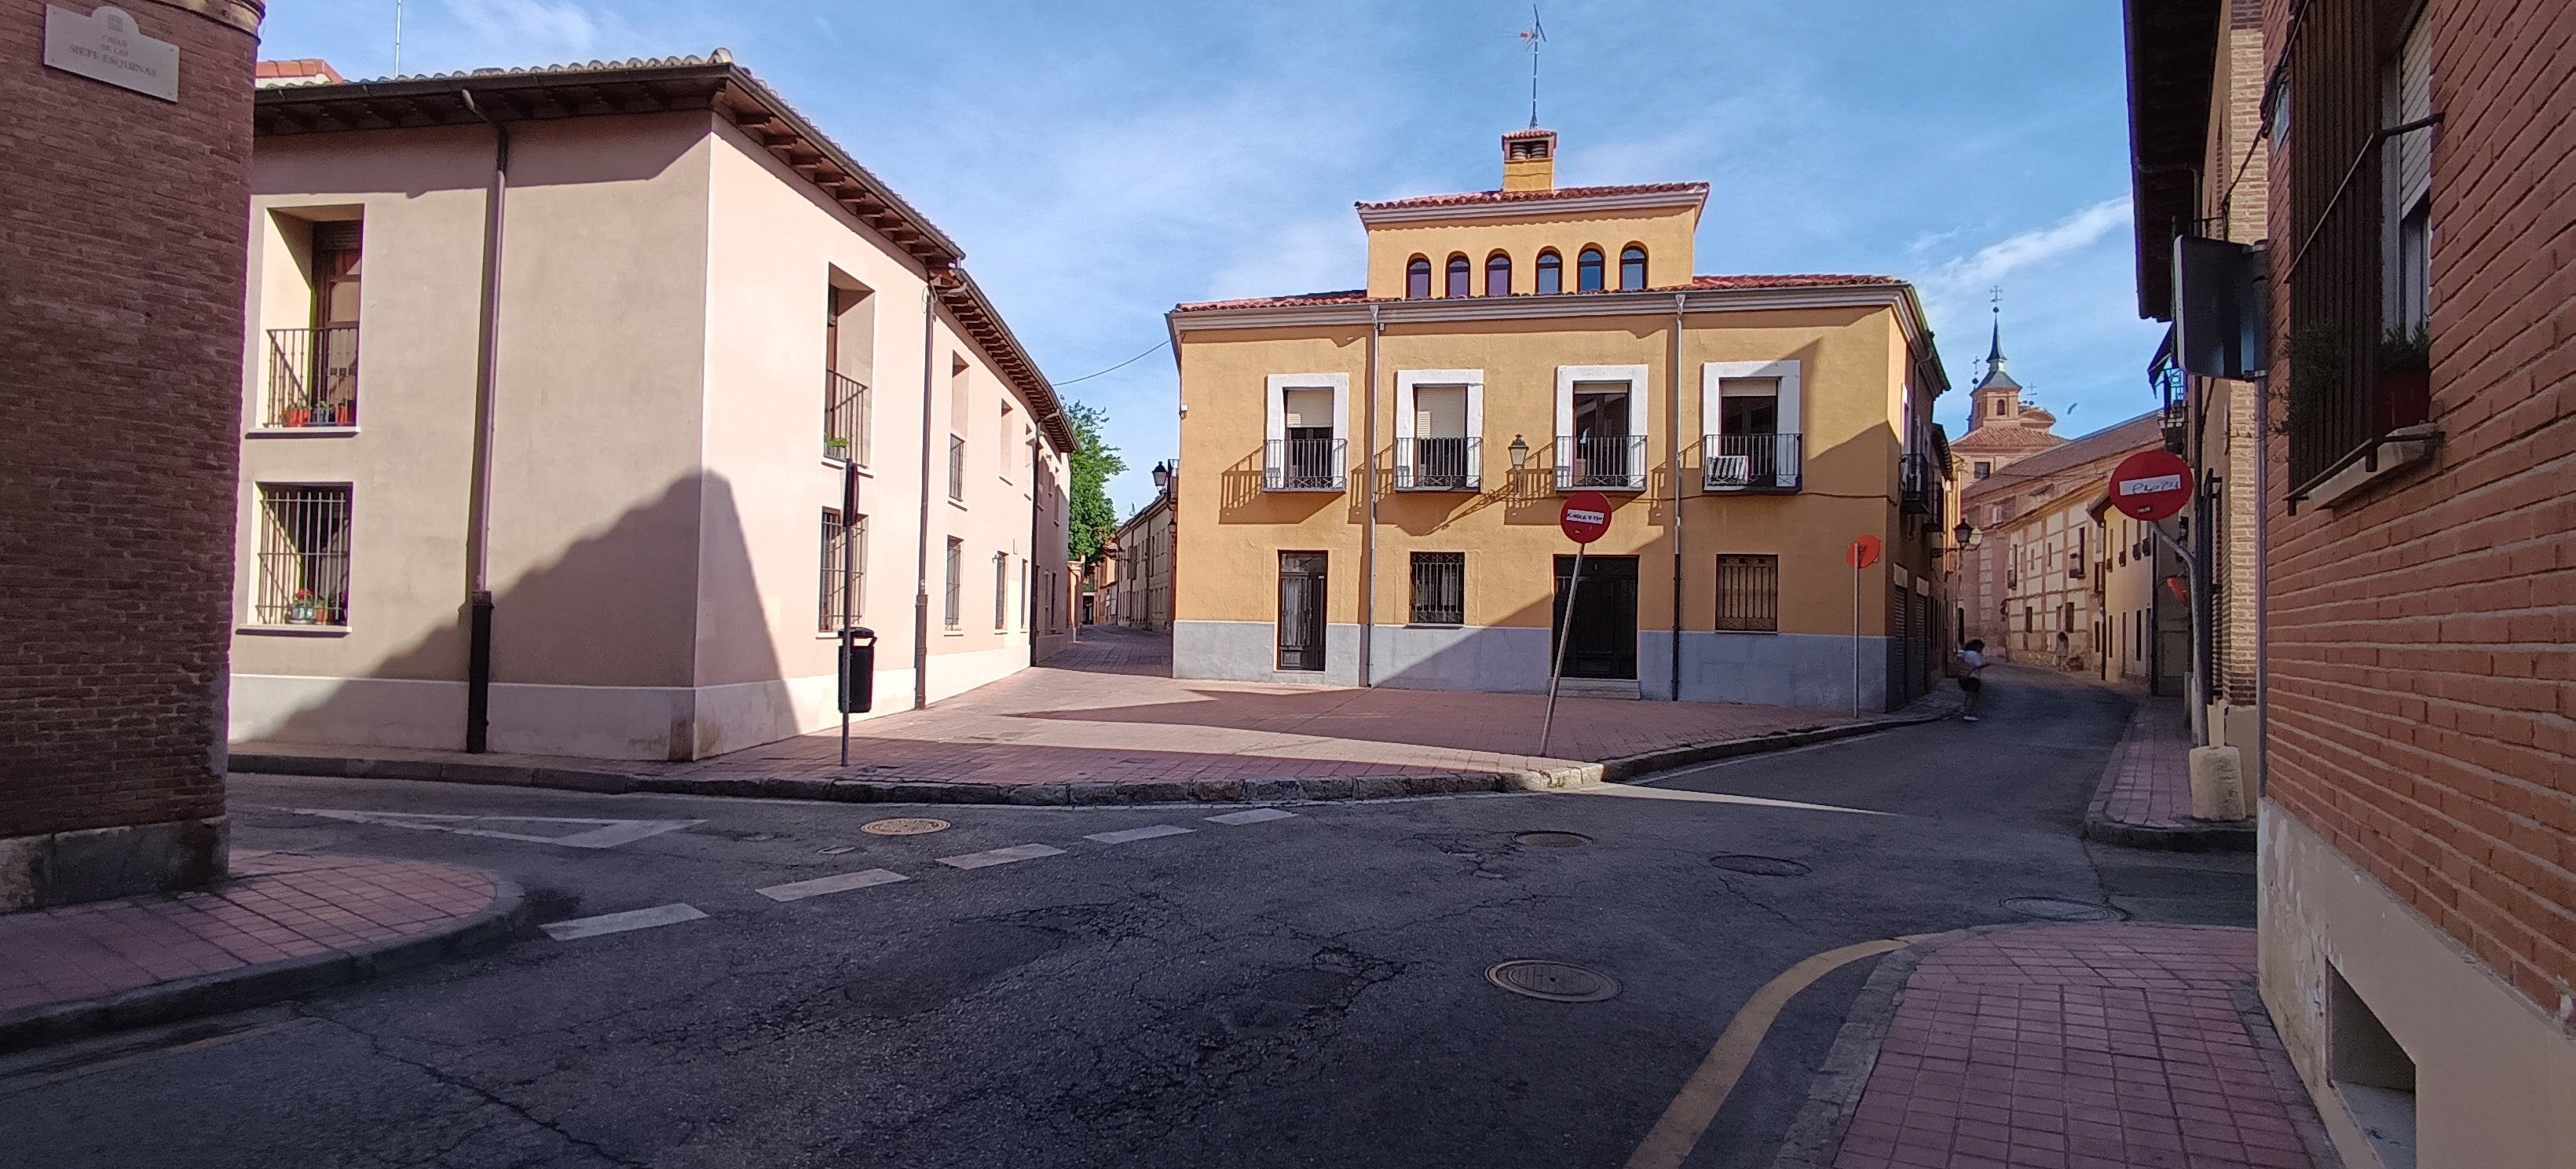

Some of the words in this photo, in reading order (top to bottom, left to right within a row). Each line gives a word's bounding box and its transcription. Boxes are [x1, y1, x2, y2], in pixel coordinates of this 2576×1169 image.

[101, 34, 127, 47] CALLE
[69, 44, 98, 60] SIETE
[102, 54, 157, 76] ESQUINAS
